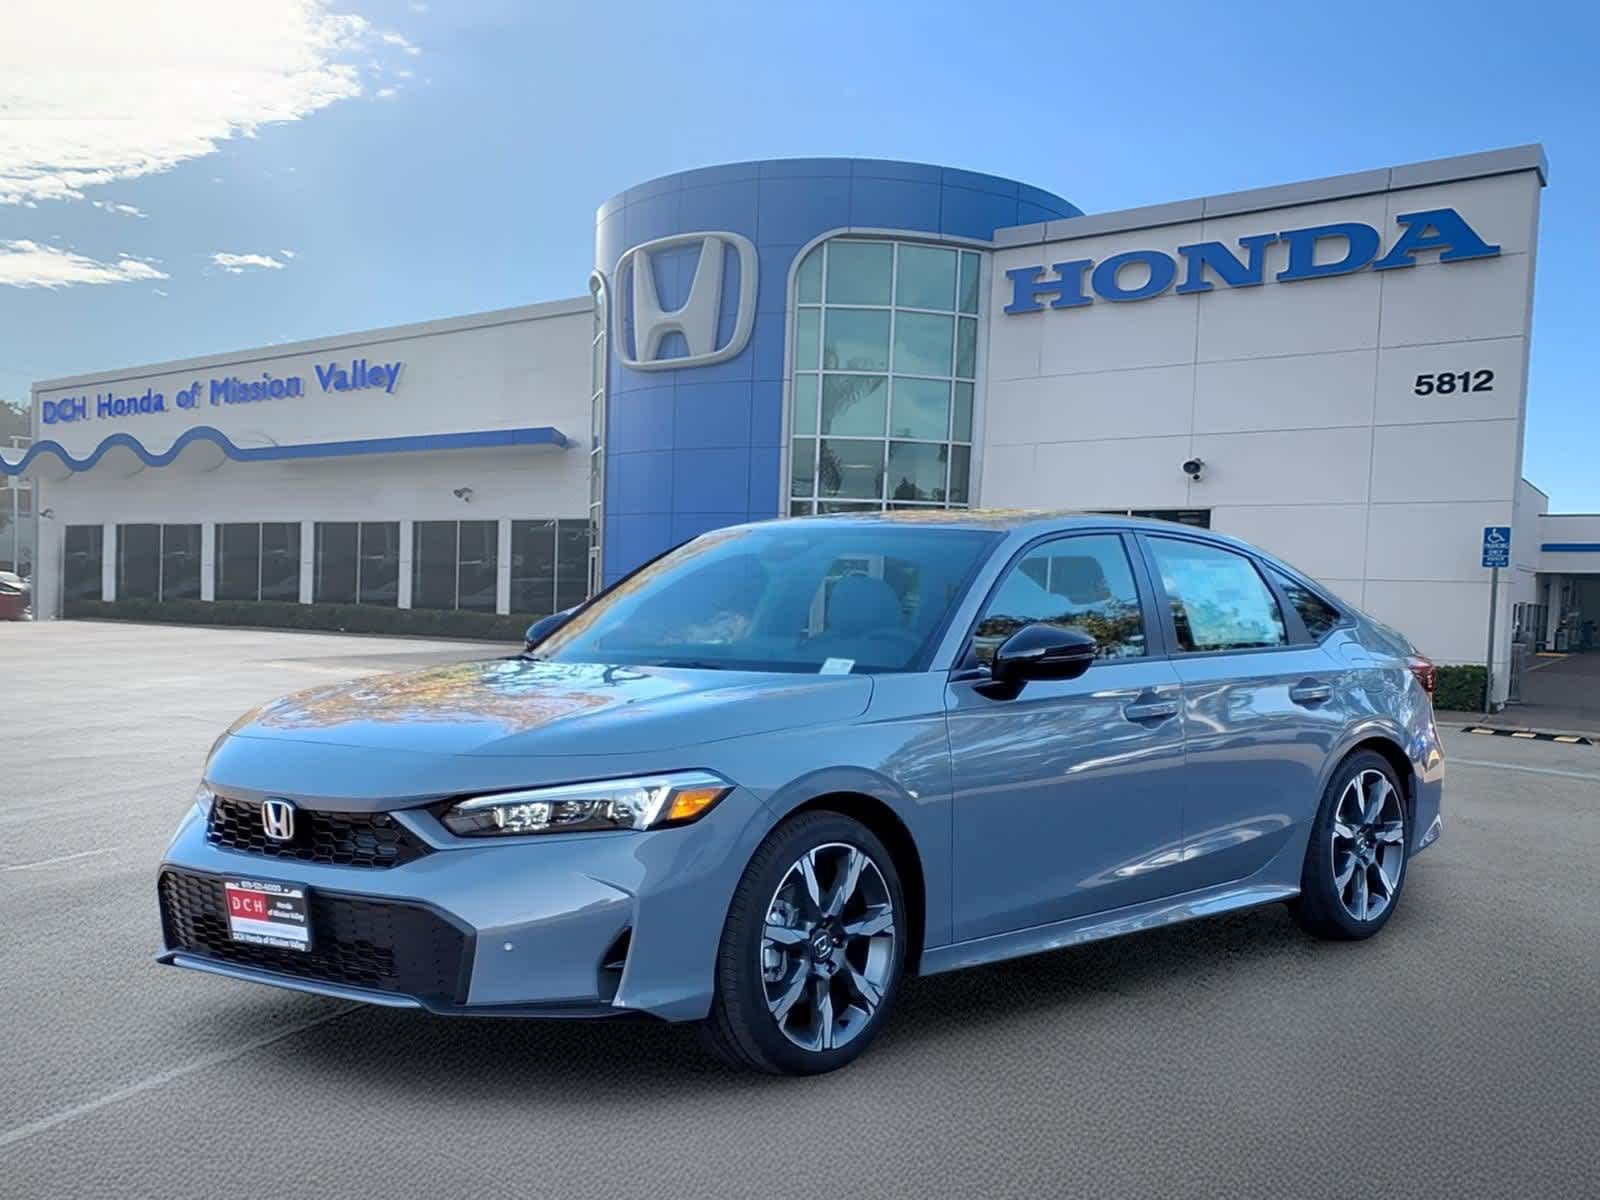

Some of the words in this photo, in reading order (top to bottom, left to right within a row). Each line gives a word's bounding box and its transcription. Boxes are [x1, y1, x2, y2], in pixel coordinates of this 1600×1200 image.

[1003, 208, 1501, 315] HONDA
[43, 397, 87, 424] DCH
[97, 388, 165, 418] Honda
[176, 381, 200, 409] of
[209, 372, 303, 406] Mission
[314, 358, 401, 394] Valley
[1414, 369, 1495, 396] 5812
[231, 896, 264, 913] DCH
